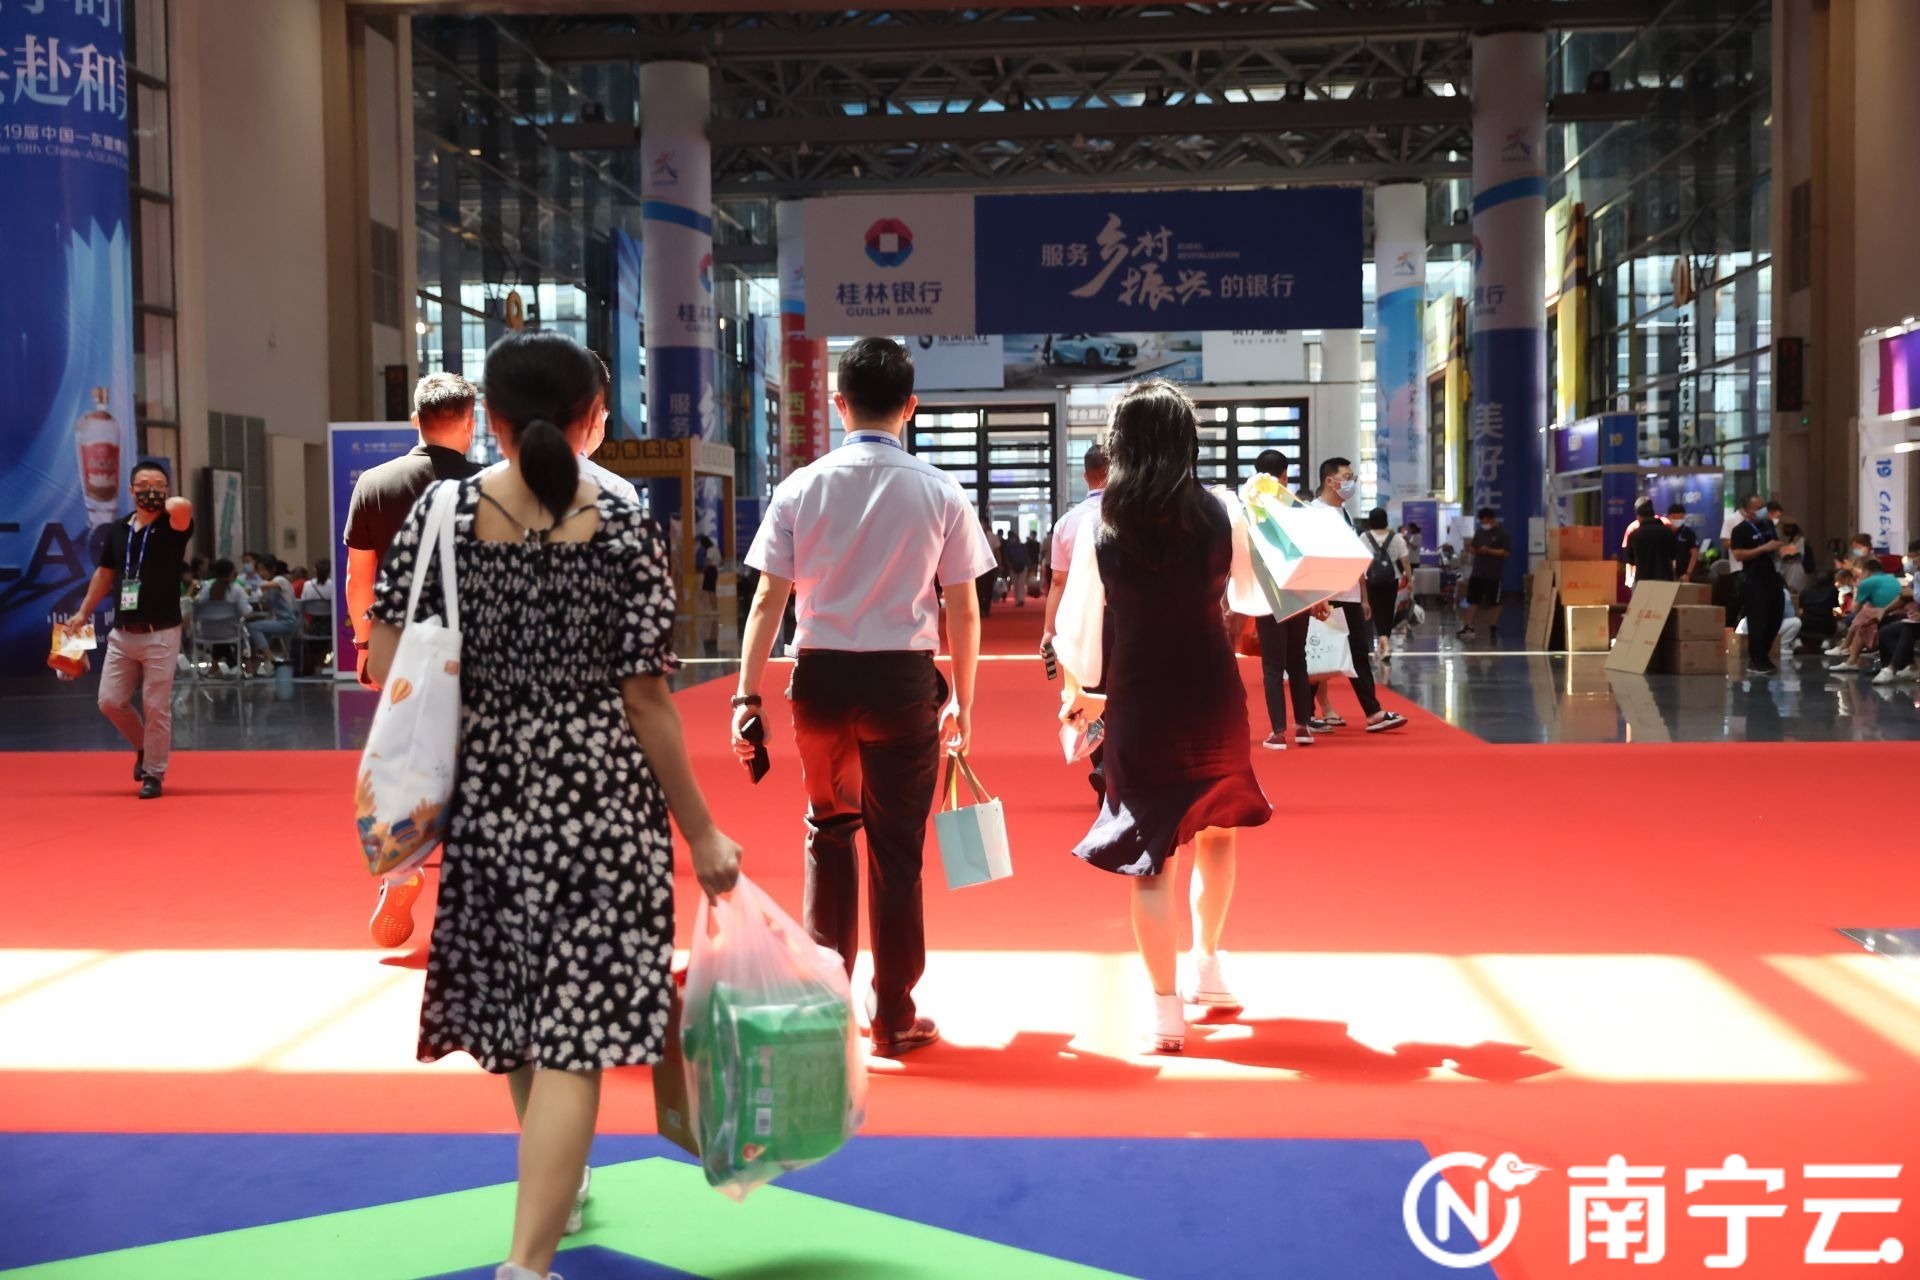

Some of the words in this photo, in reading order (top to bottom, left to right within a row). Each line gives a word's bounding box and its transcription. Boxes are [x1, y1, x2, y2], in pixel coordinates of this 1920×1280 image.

[0, 34, 128, 120] 赴和
[1041, 243, 1090, 268] 服务
[835, 280, 943, 306] 桂林银行
[1220, 273, 1295, 299] 的银行
[845, 305, 891, 318] GUILIN
[896, 305, 934, 317] BANK
